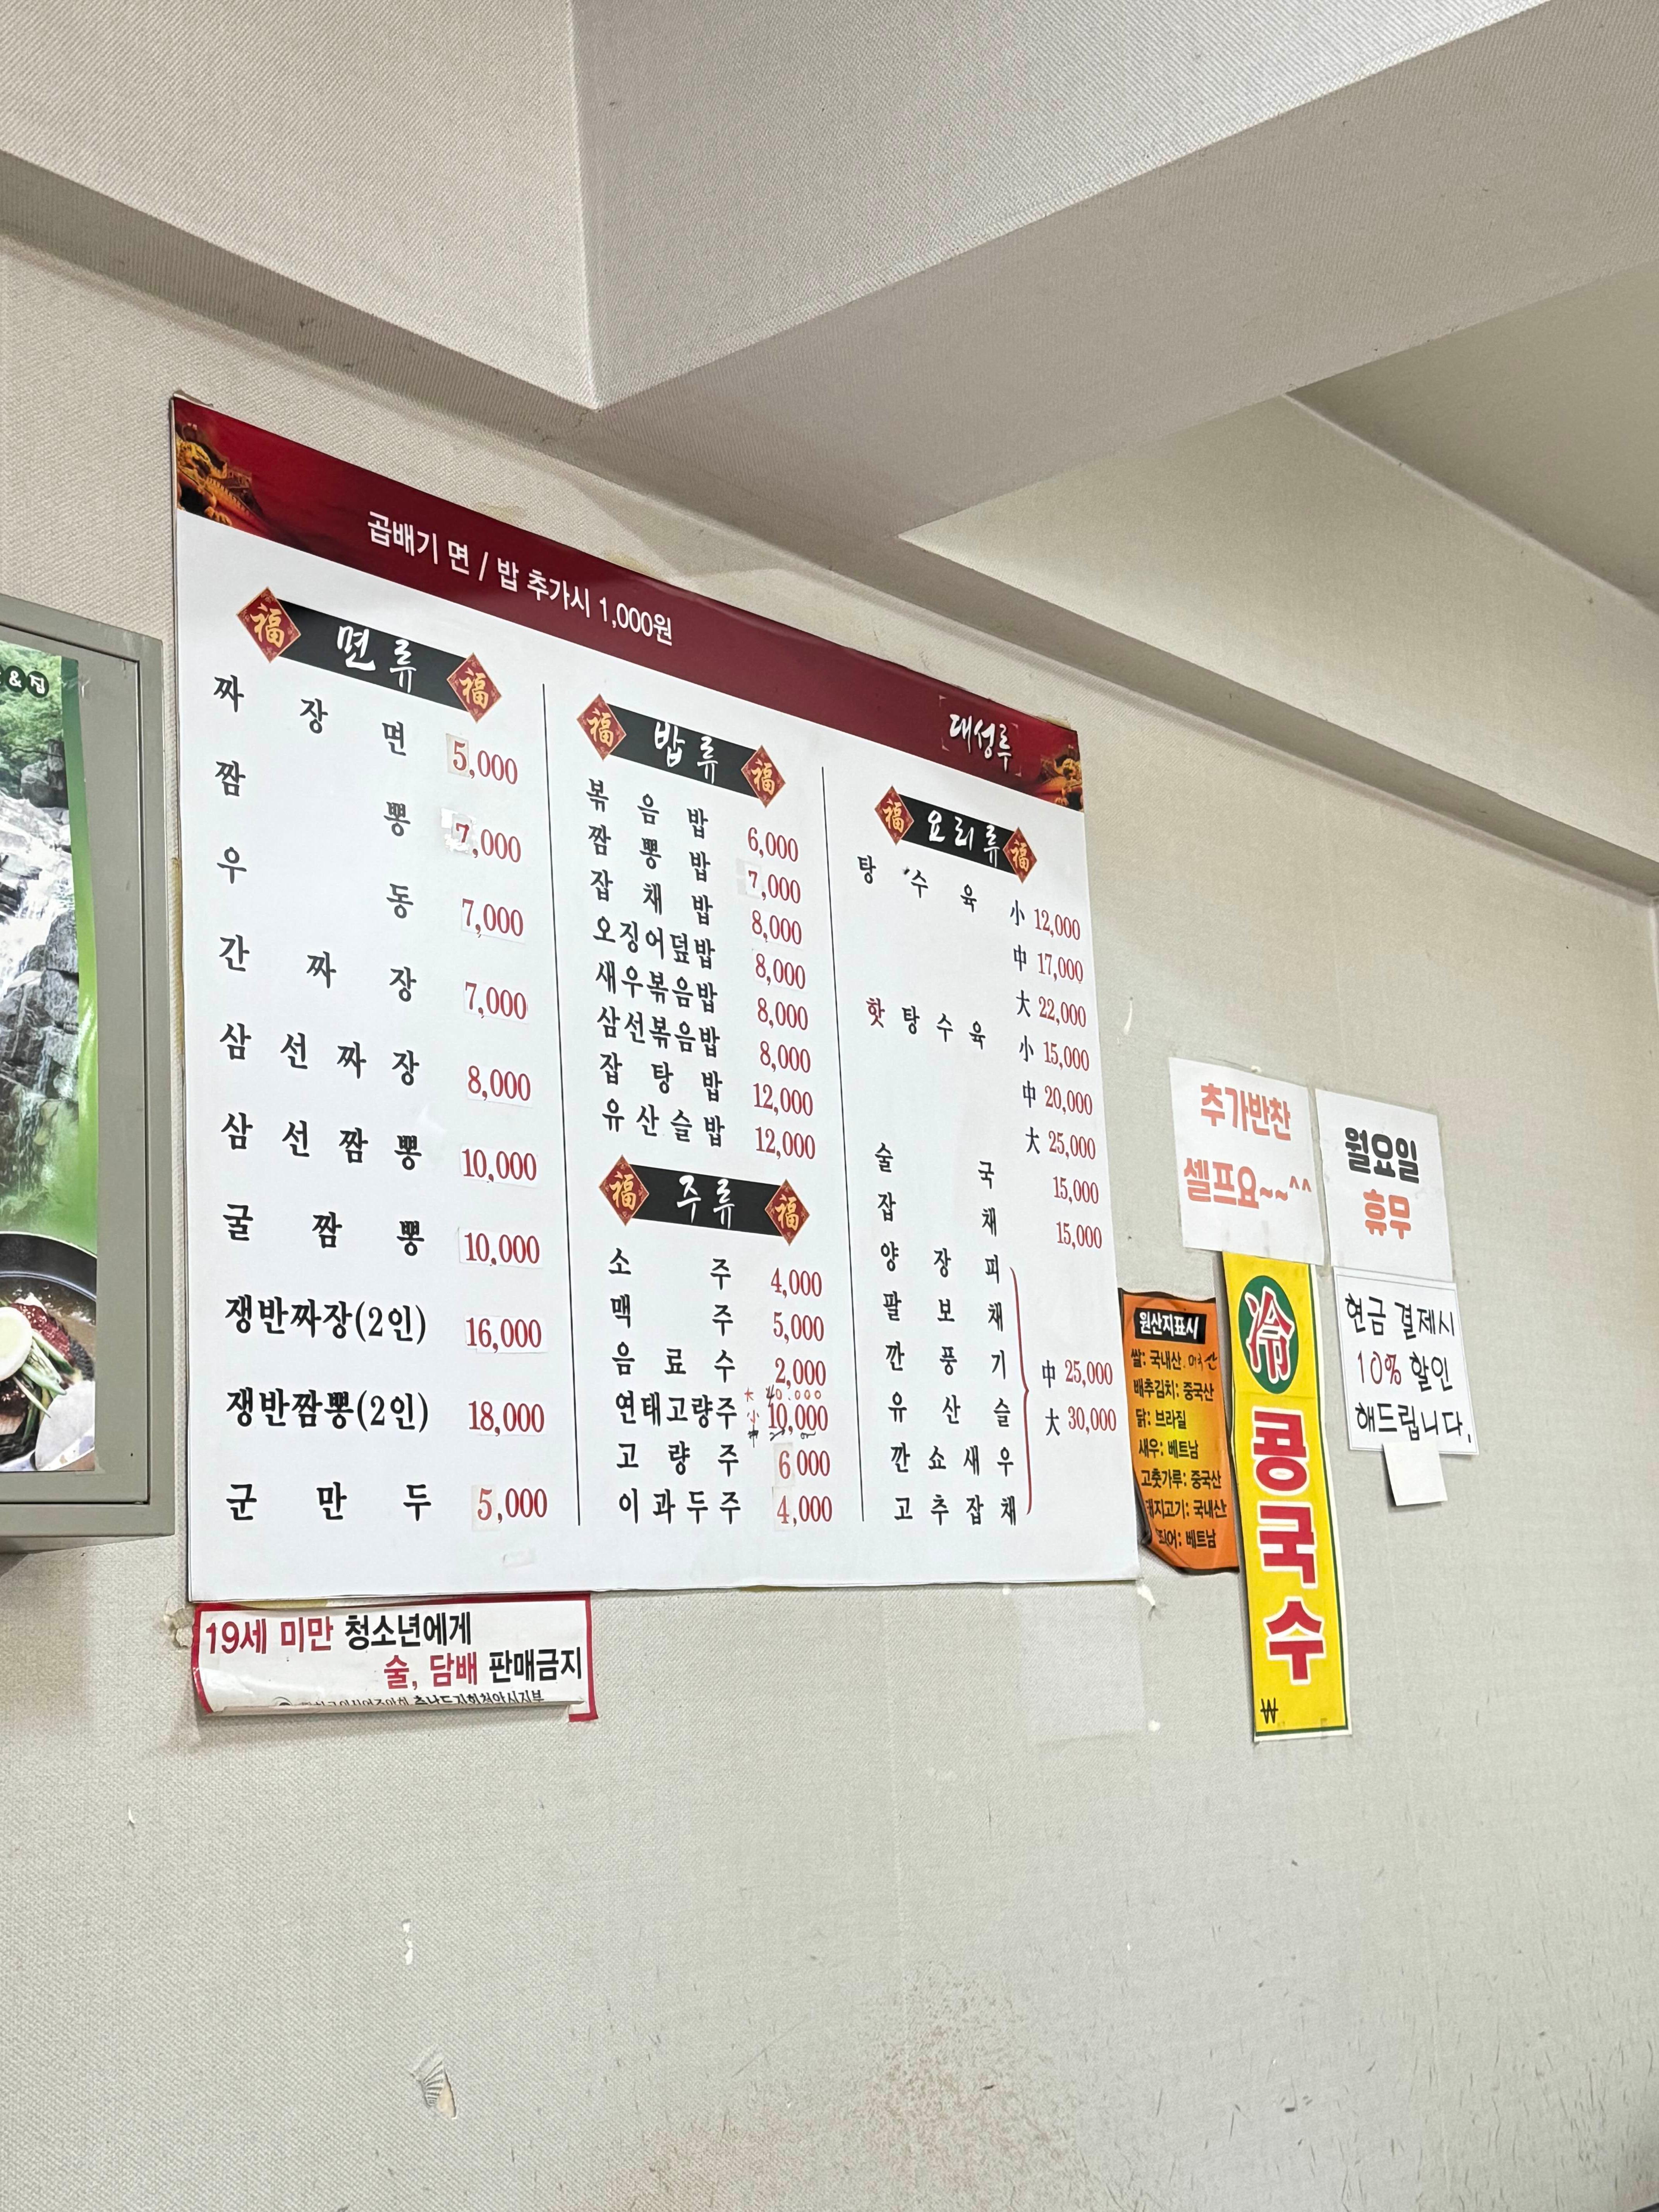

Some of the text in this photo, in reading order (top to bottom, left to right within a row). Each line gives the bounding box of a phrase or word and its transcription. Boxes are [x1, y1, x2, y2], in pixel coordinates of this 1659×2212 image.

[368, 511, 438, 564] 곱배기
[448, 541, 469, 575] 면
[497, 558, 519, 592] 밥
[527, 570, 590, 618] 추가시
[599, 597, 672, 646] 1,000원
[250, 604, 283, 647] 福
[460, 667, 489, 709] 福
[9, 670, 22, 687] &
[586, 708, 613, 747] 福
[751, 758, 775, 795] 福
[950, 714, 1012, 771] 대성루
[453, 740, 518, 785] 5,000
[456, 823, 521, 863] 7,000
[748, 827, 799, 862] 6,000
[883, 799, 904, 833] 福
[1010, 839, 1030, 872] 福
[748, 870, 801, 904] 7,000
[462, 898, 524, 937] 7,000
[752, 910, 802, 945] 8,000
[1010, 900, 1025, 926] 小
[1034, 908, 1080, 940] 12,000
[593, 916, 805, 986] 오징어덮밥 8,000
[1013, 944, 1083, 982] 中 17,000
[465, 982, 528, 1019] 7,000
[596, 960, 808, 1030] 새우볶음밥 8,000
[1016, 989, 1086, 1027] 大 22,000
[597, 1006, 811, 1073] 삼선볶음밥 8,000
[1019, 1035, 1034, 1062] 小
[1043, 1041, 1089, 1071] 15,000
[468, 1065, 531, 1101] 8,000
[753, 1083, 813, 1116] 12,000
[1022, 1080, 1092, 1115] 中 20,000
[1201, 1083, 1291, 1141] 추가반찬
[755, 1127, 816, 1159] 12,000
[1025, 1126, 1096, 1159] 大 25,000
[1345, 1127, 1419, 1184] 월요일
[462, 1149, 537, 1183] 10,000
[610, 1171, 635, 1211] 福
[775, 1194, 799, 1231] 福
[1053, 1176, 1099, 1204] 15,000
[1364, 1189, 1411, 1239] 휴무
[464, 1233, 540, 1266] 10,000
[1056, 1221, 1102, 1249] 15,000
[771, 1268, 822, 1297] 4,000
[225, 1294, 542, 1353] 쟁반짜장(2인) 16,000
[773, 1312, 824, 1344] 5,000
[1139, 1311, 1199, 1340] 원산지표시
[1345, 1293, 1455, 1340] 현금 결제시
[1245, 1286, 1296, 1384] 冷
[775, 1357, 826, 1389] 2,000
[1042, 1360, 1113, 1388] 中 25,000
[1131, 1348, 1146, 1368] 쌀:
[1358, 1350, 1453, 1392] 10% 할인
[1133, 1378, 1214, 1401] 배추김치: 중국산
[226, 1387, 544, 1437] 쟁반짬뽕(2인) 18,000
[616, 1390, 737, 1430] 연태고량주
[768, 1403, 828, 1435] 10,000
[1045, 1406, 1116, 1436] 大 30,000
[1135, 1410, 1187, 1429] 닭: 브라질
[1139, 1438, 1199, 1459] 새우: 베트남
[1141, 1468, 1221, 1489] 고춧가루: 중국산
[477, 1488, 548, 1523] 5,000
[777, 1495, 832, 1527] 4,000
[1193, 1499, 1227, 1519] 국내산
[1185, 1528, 1216, 1549] 베트남
[1253, 1408, 1324, 1683] 콩국수
[205, 1611, 472, 1654] 19세 미만 청소년에게
[383, 1647, 582, 1691] 술, 담배 판매금지
